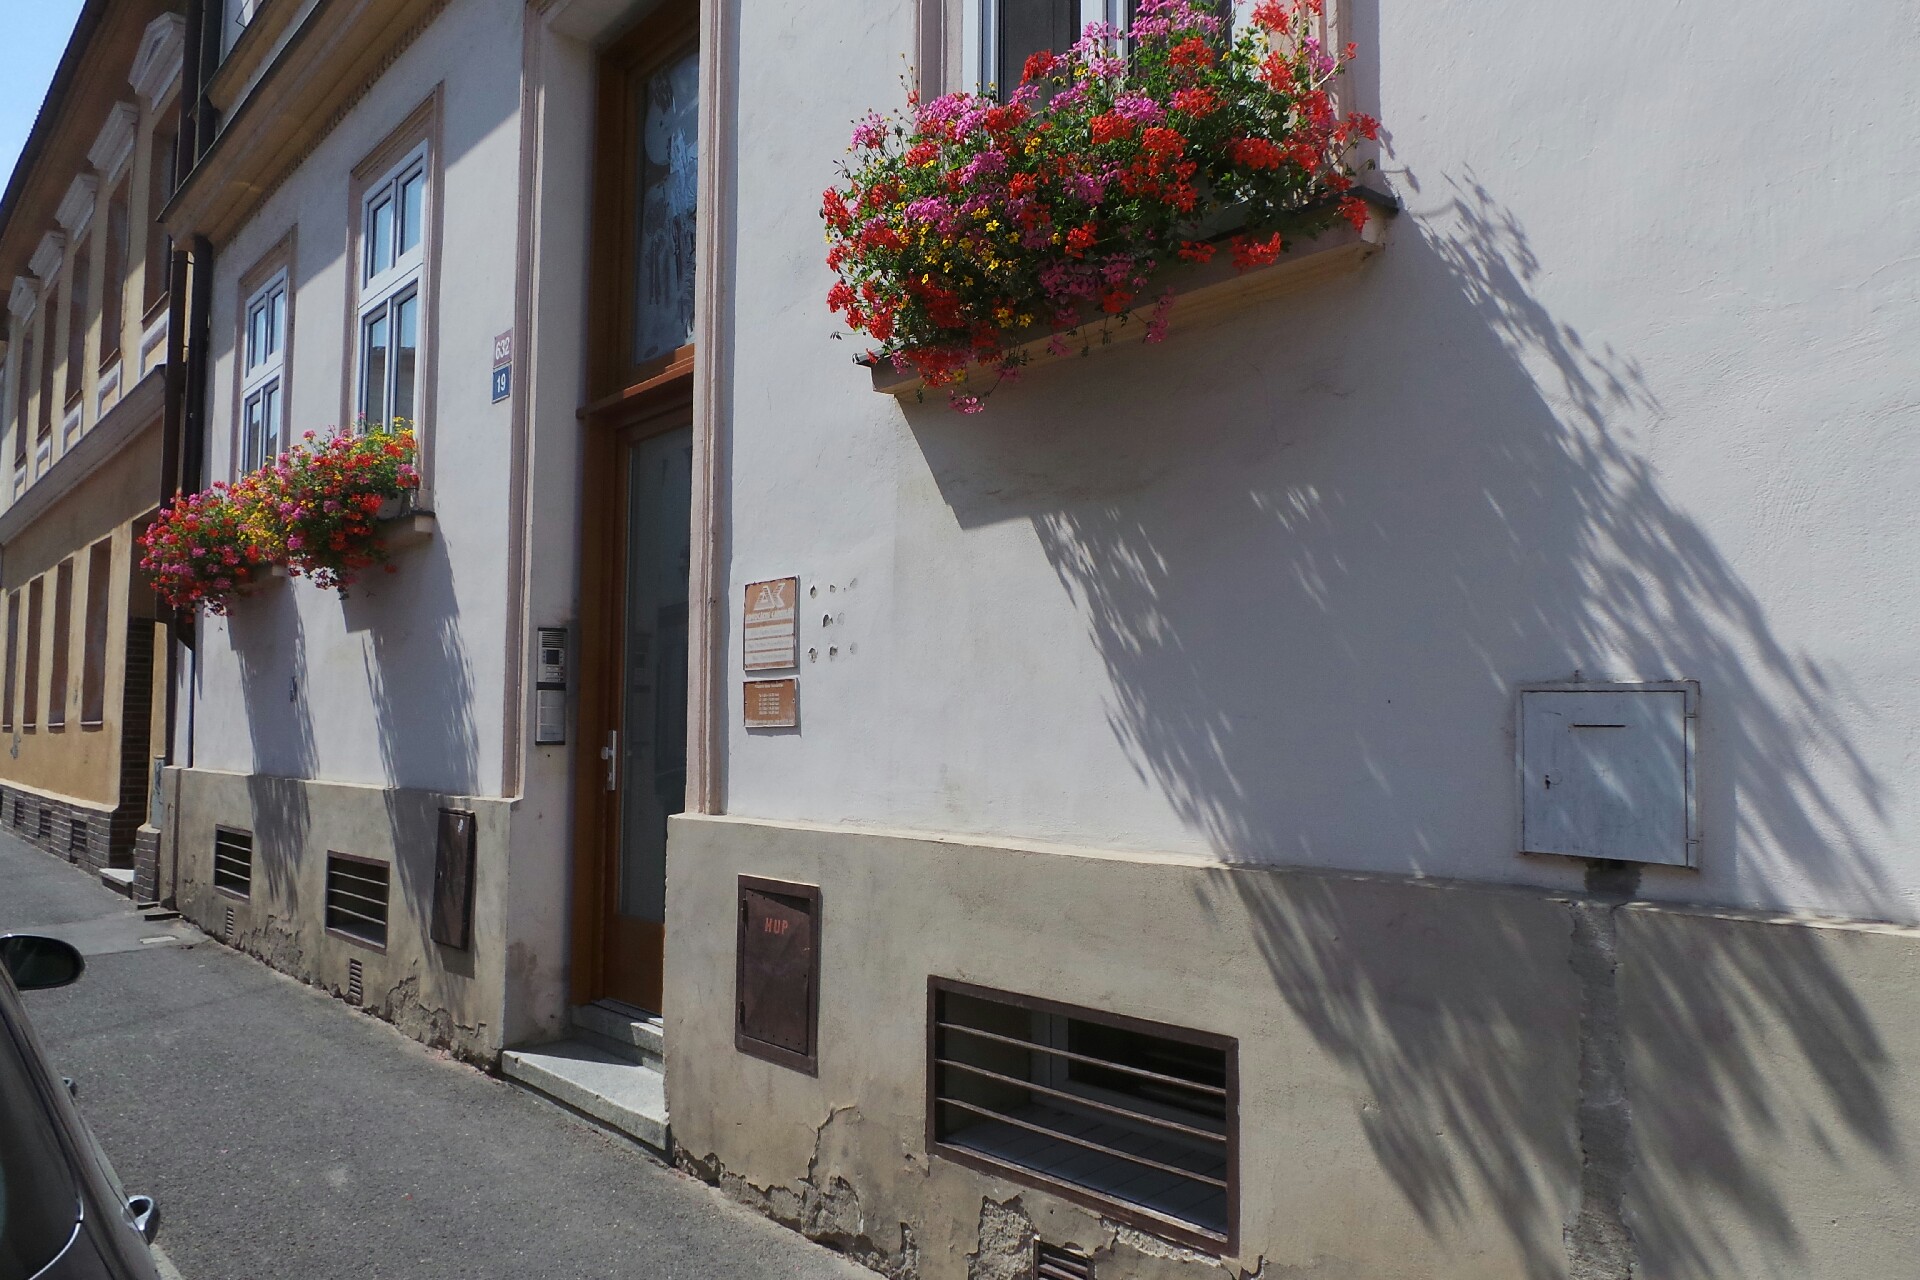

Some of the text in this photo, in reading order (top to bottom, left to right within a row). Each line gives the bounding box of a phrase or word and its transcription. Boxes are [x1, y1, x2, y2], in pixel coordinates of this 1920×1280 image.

[496, 337, 510, 360] 632
[497, 373, 506, 393] 19
[764, 917, 789, 935] HUP
